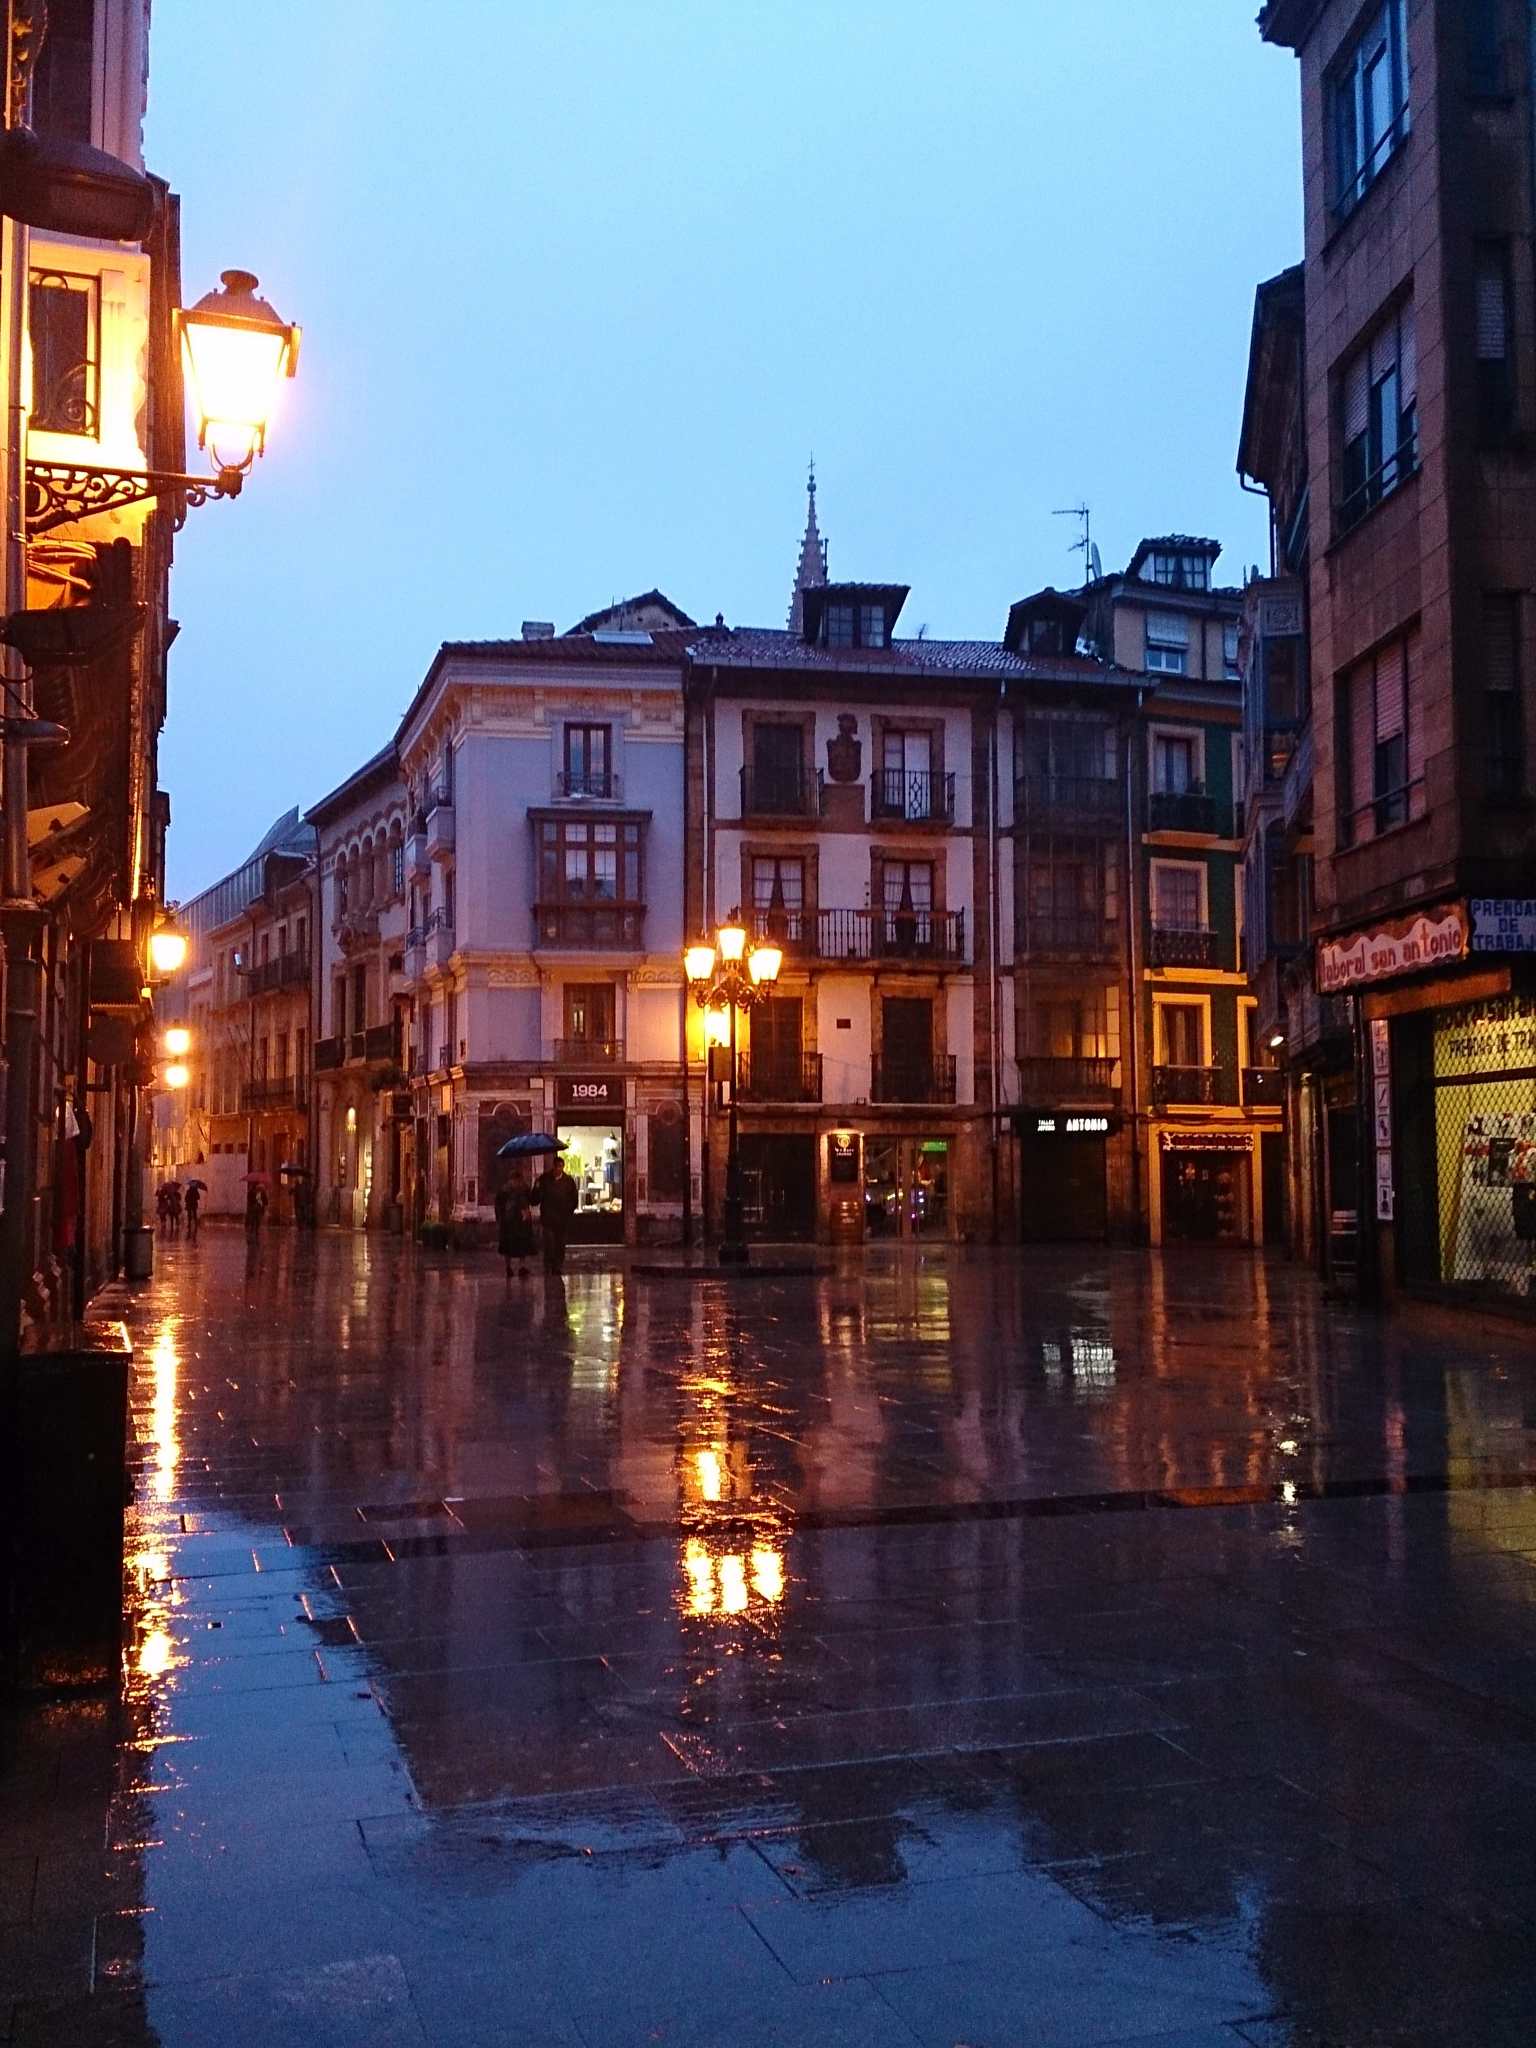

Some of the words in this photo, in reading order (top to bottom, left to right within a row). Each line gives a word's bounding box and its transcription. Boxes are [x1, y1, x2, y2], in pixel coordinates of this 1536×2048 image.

[1499, 918, 1519, 933] DE
[1322, 943, 1366, 983] laboral
[1370, 947, 1397, 971] san
[1402, 922, 1462, 963] antonio
[572, 1084, 608, 1097] 1984
[1066, 1118, 1108, 1131] ANTONIO
